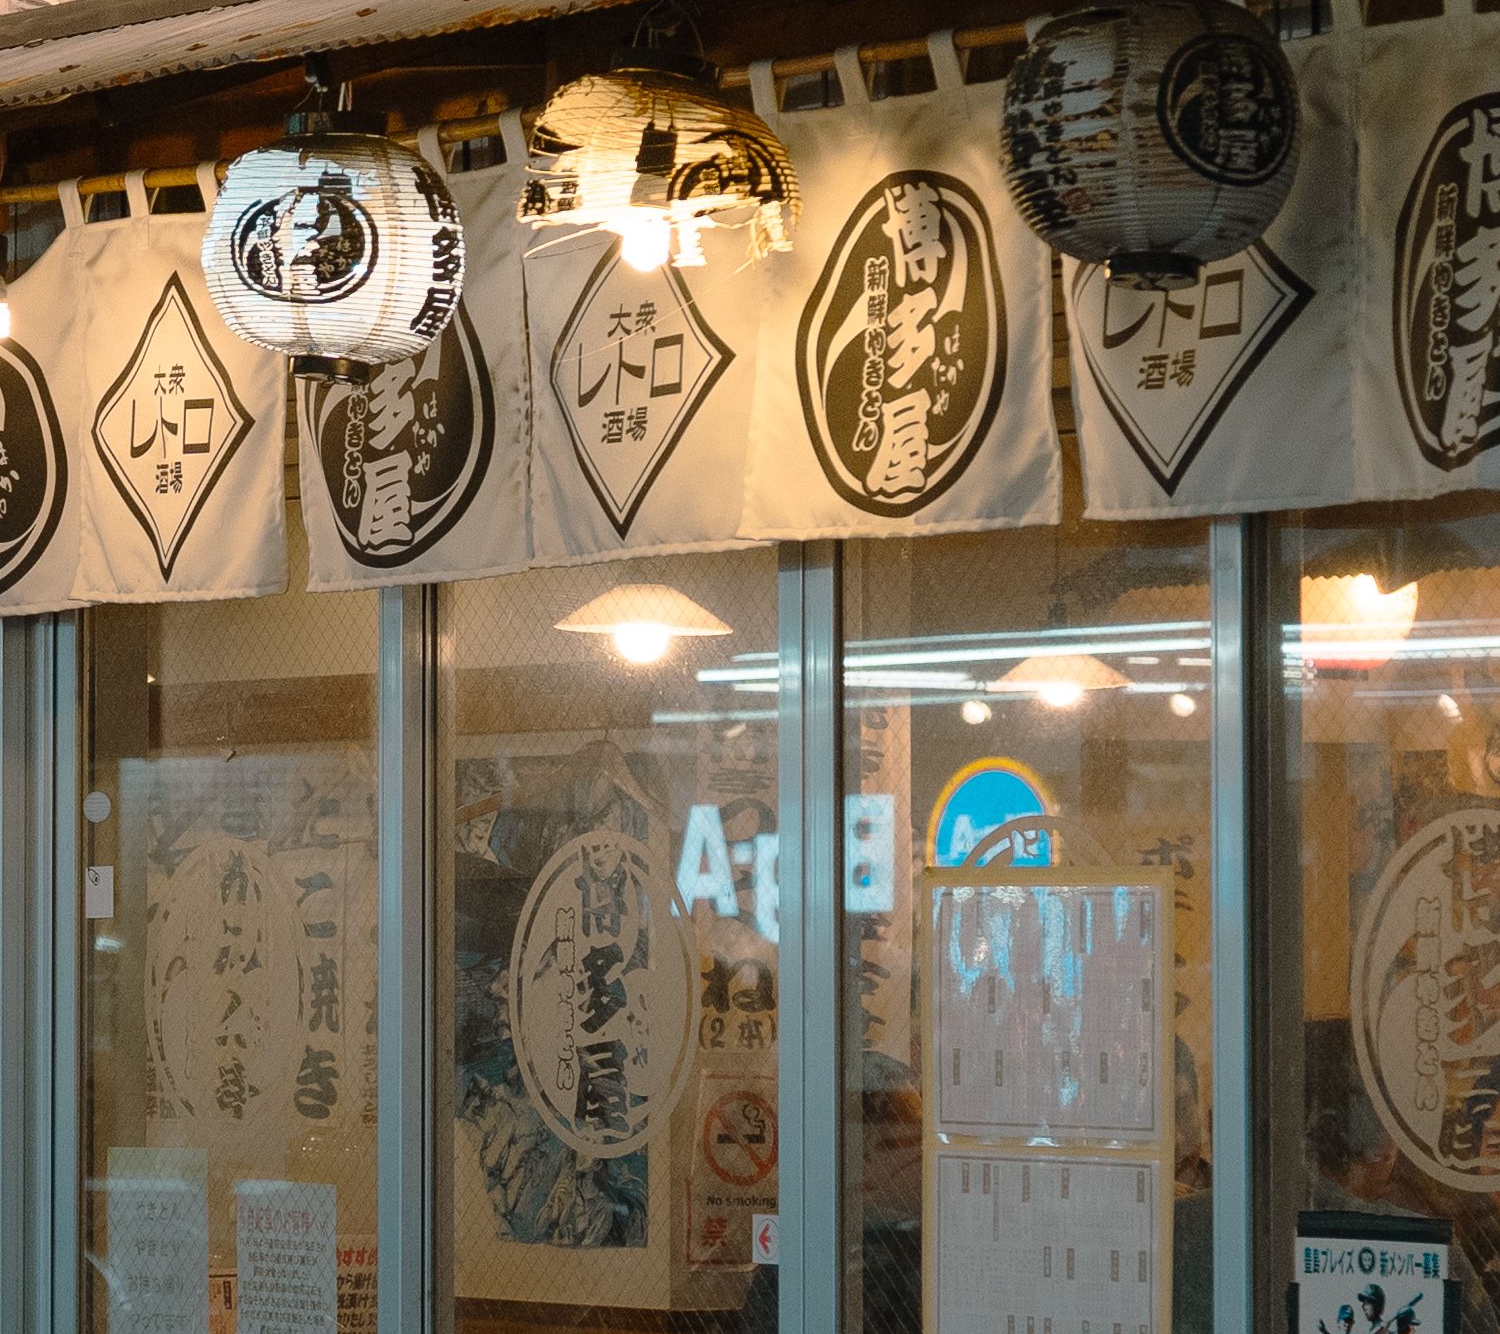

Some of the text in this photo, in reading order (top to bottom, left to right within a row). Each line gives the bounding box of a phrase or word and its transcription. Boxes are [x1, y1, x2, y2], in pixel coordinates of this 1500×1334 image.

[607, 300, 658, 339] 大衆
[864, 181, 946, 499] 博多屋
[153, 364, 186, 396] 大衆
[577, 333, 686, 408] レトロ
[853, 255, 890, 453] 新鮮やきとん
[930, 323, 965, 418] はかたや
[1137, 350, 1198, 392] 酒場
[130, 395, 215, 459] レトロ
[358, 357, 417, 551] 多屋
[411, 391, 445, 477] はかたや
[600, 407, 649, 446] 酒場
[154, 461, 183, 496] 酒場
[724, 1194, 777, 1211] smoking
